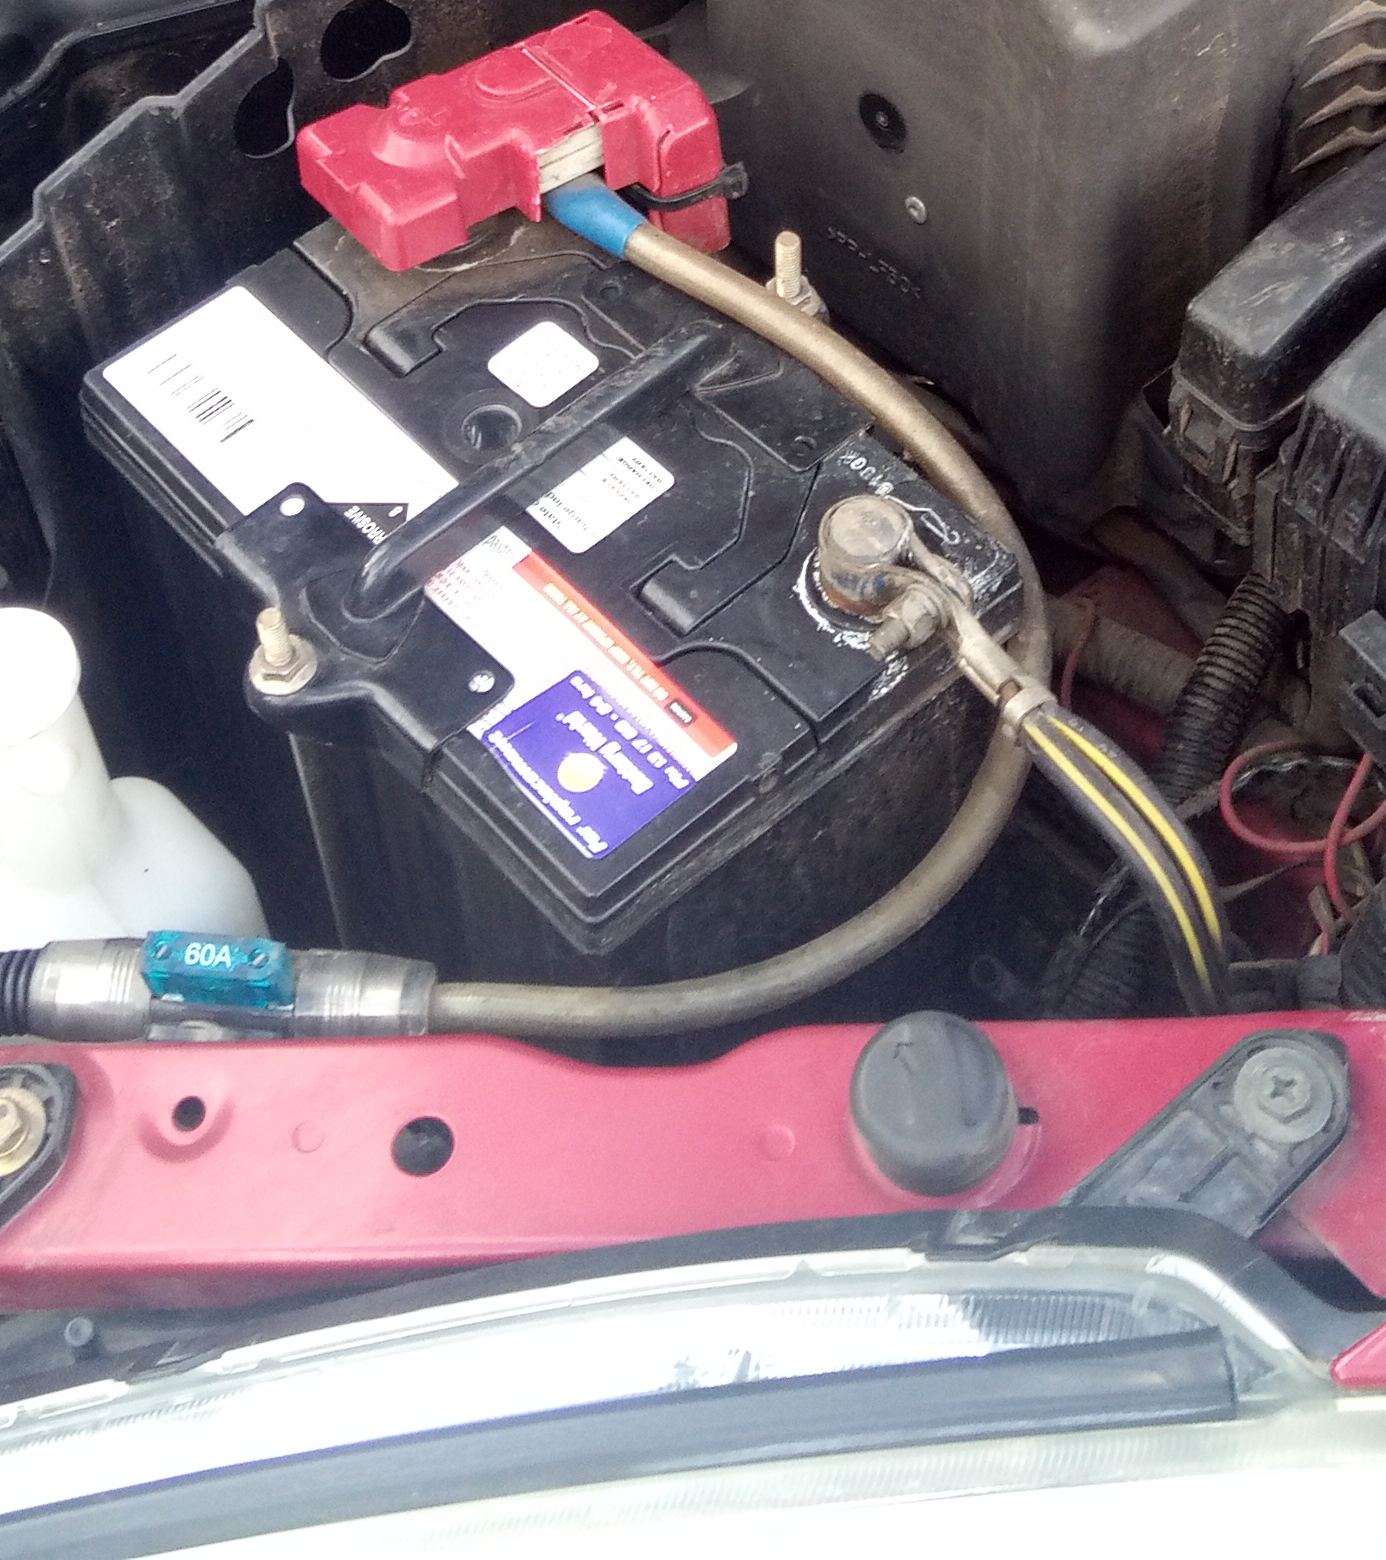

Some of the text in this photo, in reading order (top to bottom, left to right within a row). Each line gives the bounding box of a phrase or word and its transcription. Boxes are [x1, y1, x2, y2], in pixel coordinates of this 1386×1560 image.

[344, 505, 388, 545] RROSIVE
[487, 729, 582, 827] replacement
[599, 741, 654, 796] Battery
[576, 825, 609, 854] For
[184, 941, 233, 968] 60A
